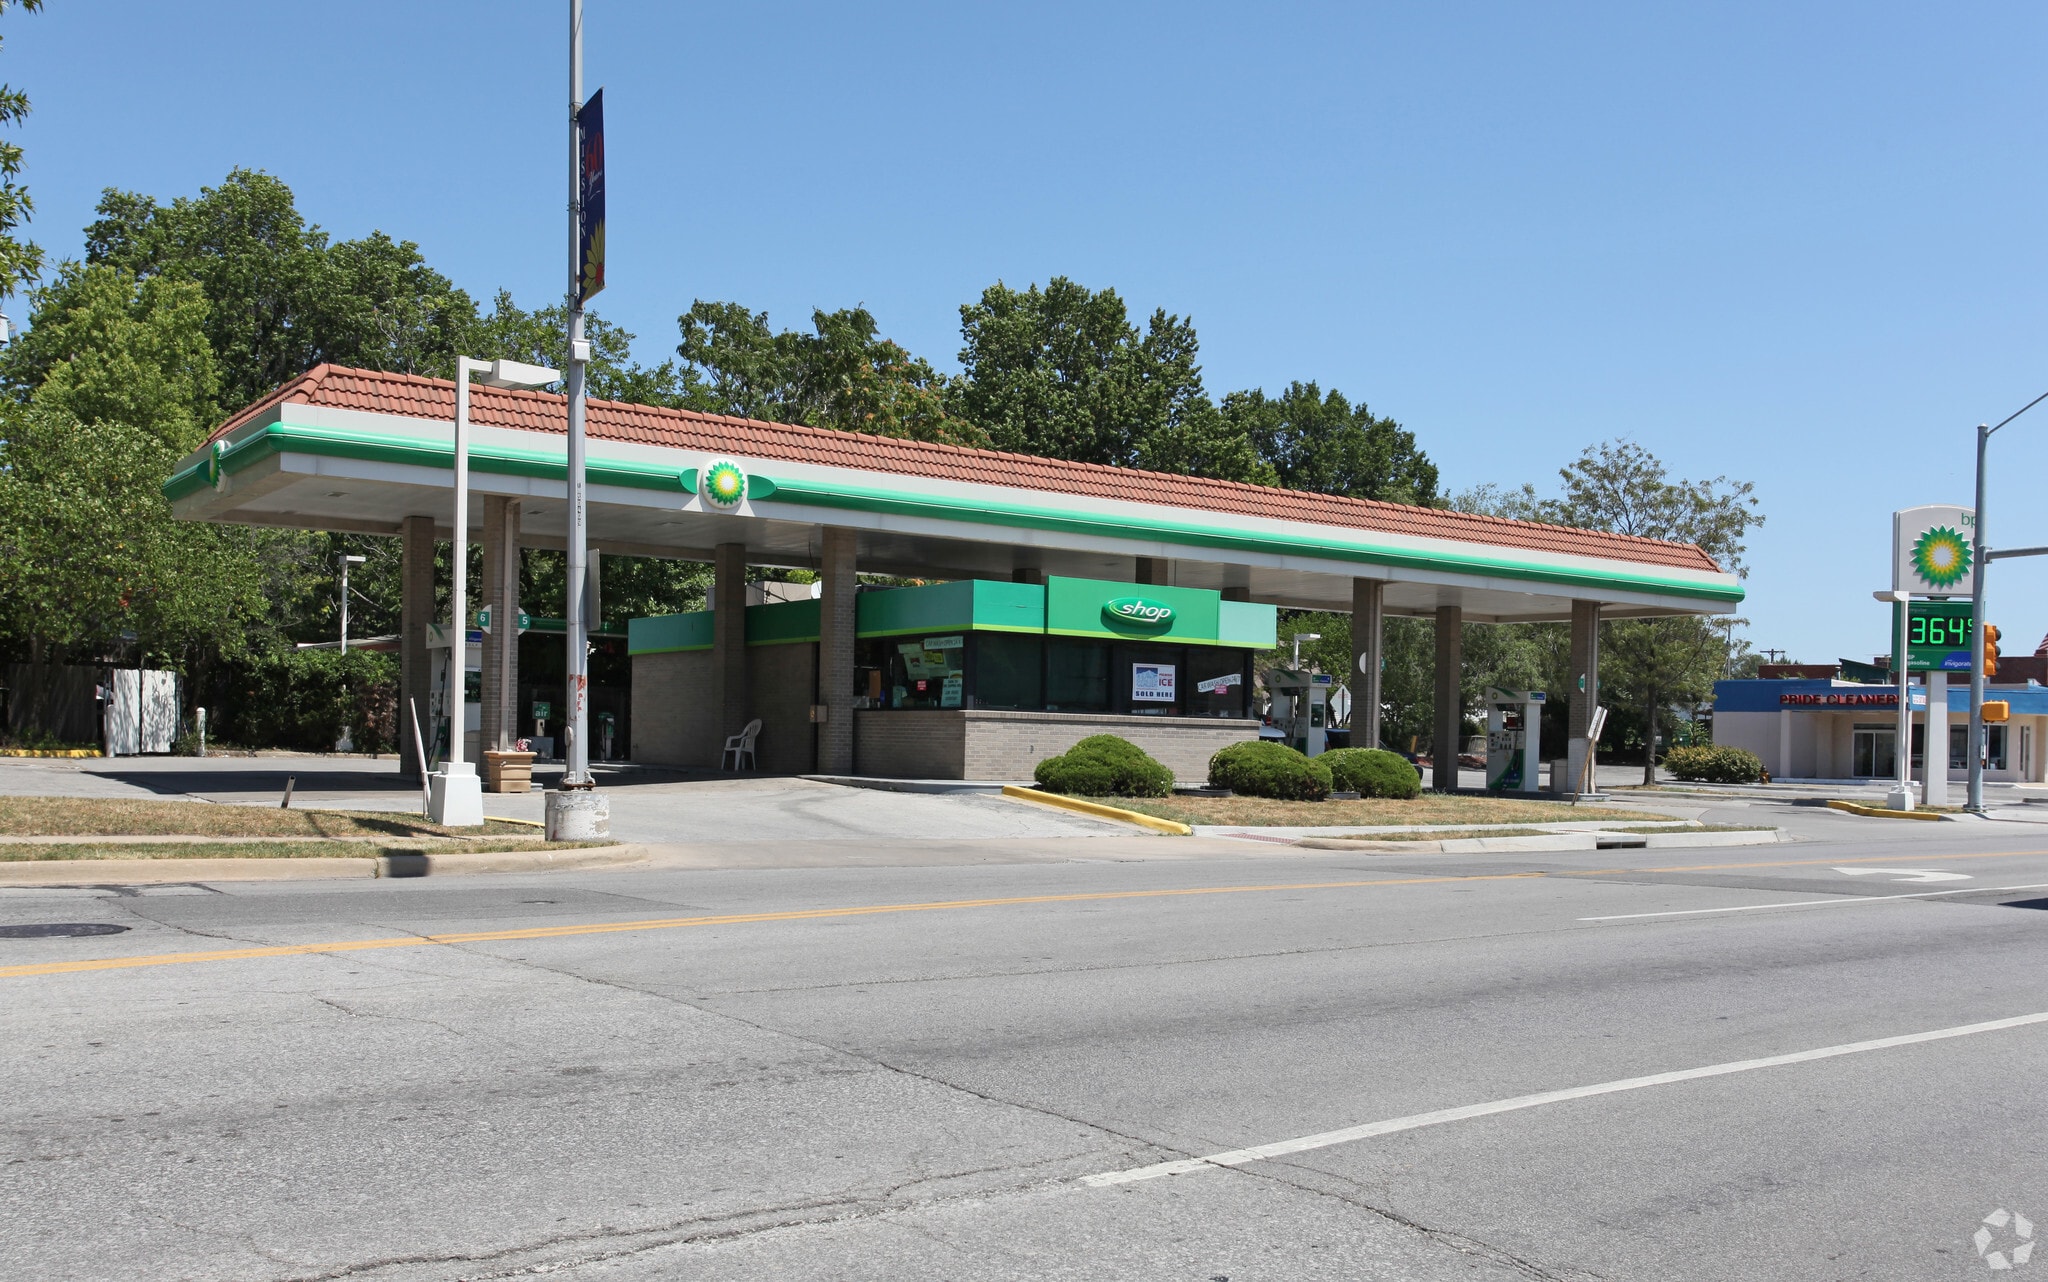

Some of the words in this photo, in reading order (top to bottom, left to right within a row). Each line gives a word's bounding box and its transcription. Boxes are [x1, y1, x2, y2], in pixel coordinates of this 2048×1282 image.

[586, 132, 603, 178] 60
[1121, 600, 1171, 622] shop
[480, 613, 486, 622] 6
[522, 616, 528, 625] 5
[1159, 679, 1173, 687] ICE
[1780, 694, 1823, 705] PRIDE
[1826, 694, 1900, 706] CLEANER
[535, 710, 548, 718] air
